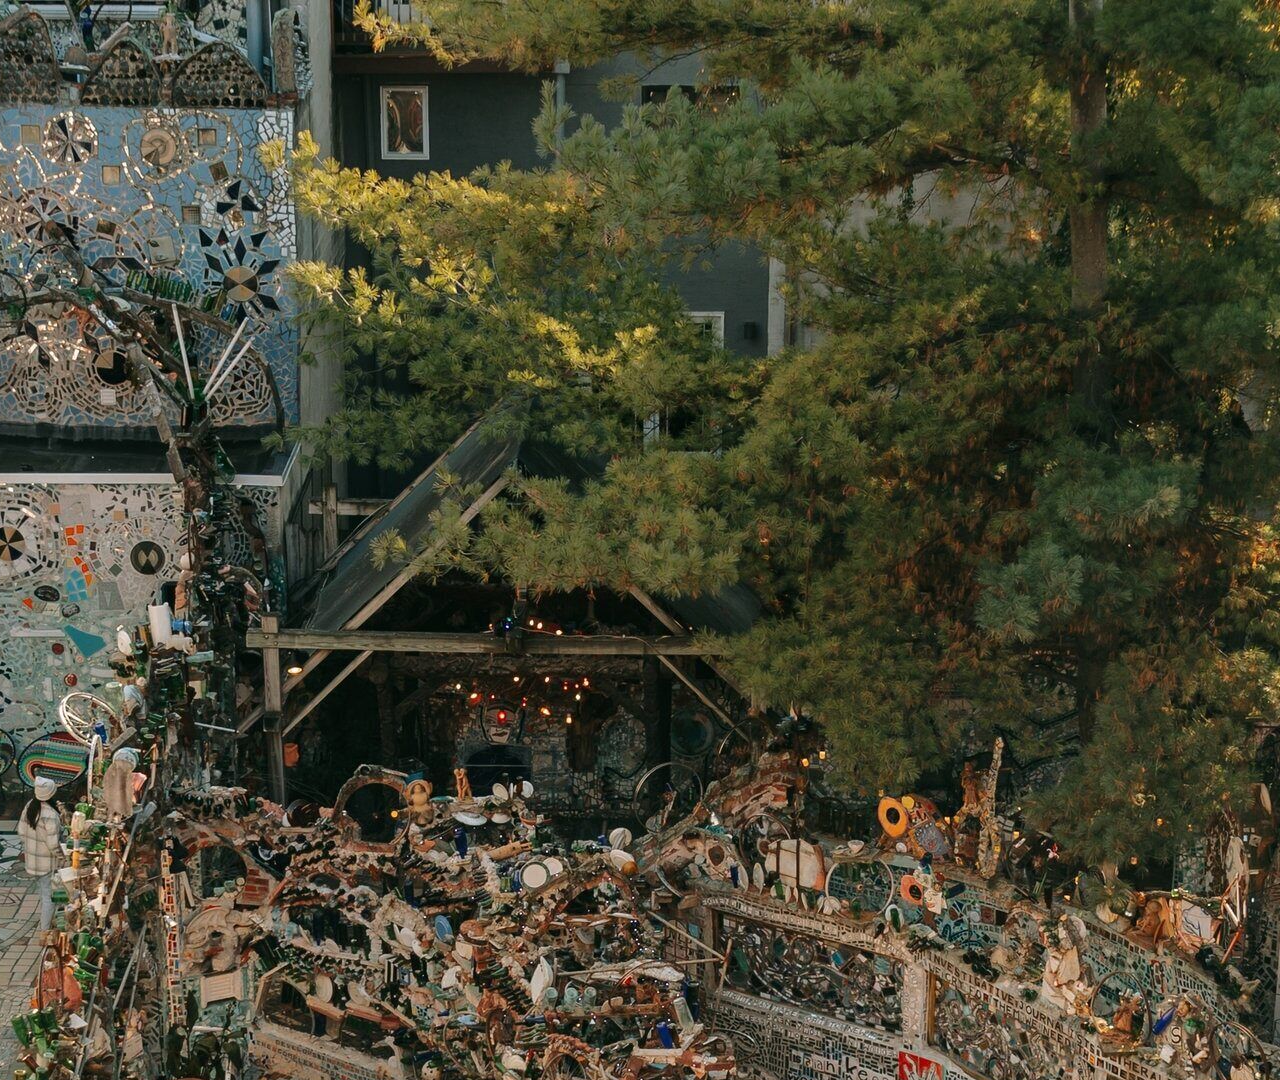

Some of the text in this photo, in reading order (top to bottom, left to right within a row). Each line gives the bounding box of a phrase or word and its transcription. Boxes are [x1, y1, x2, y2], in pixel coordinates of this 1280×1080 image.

[929, 953, 1014, 1006] INVESTIGATIVE
[969, 986, 990, 1003] FOR
[993, 998, 1020, 1021] THEM
[1043, 1026, 1071, 1047] NEED
